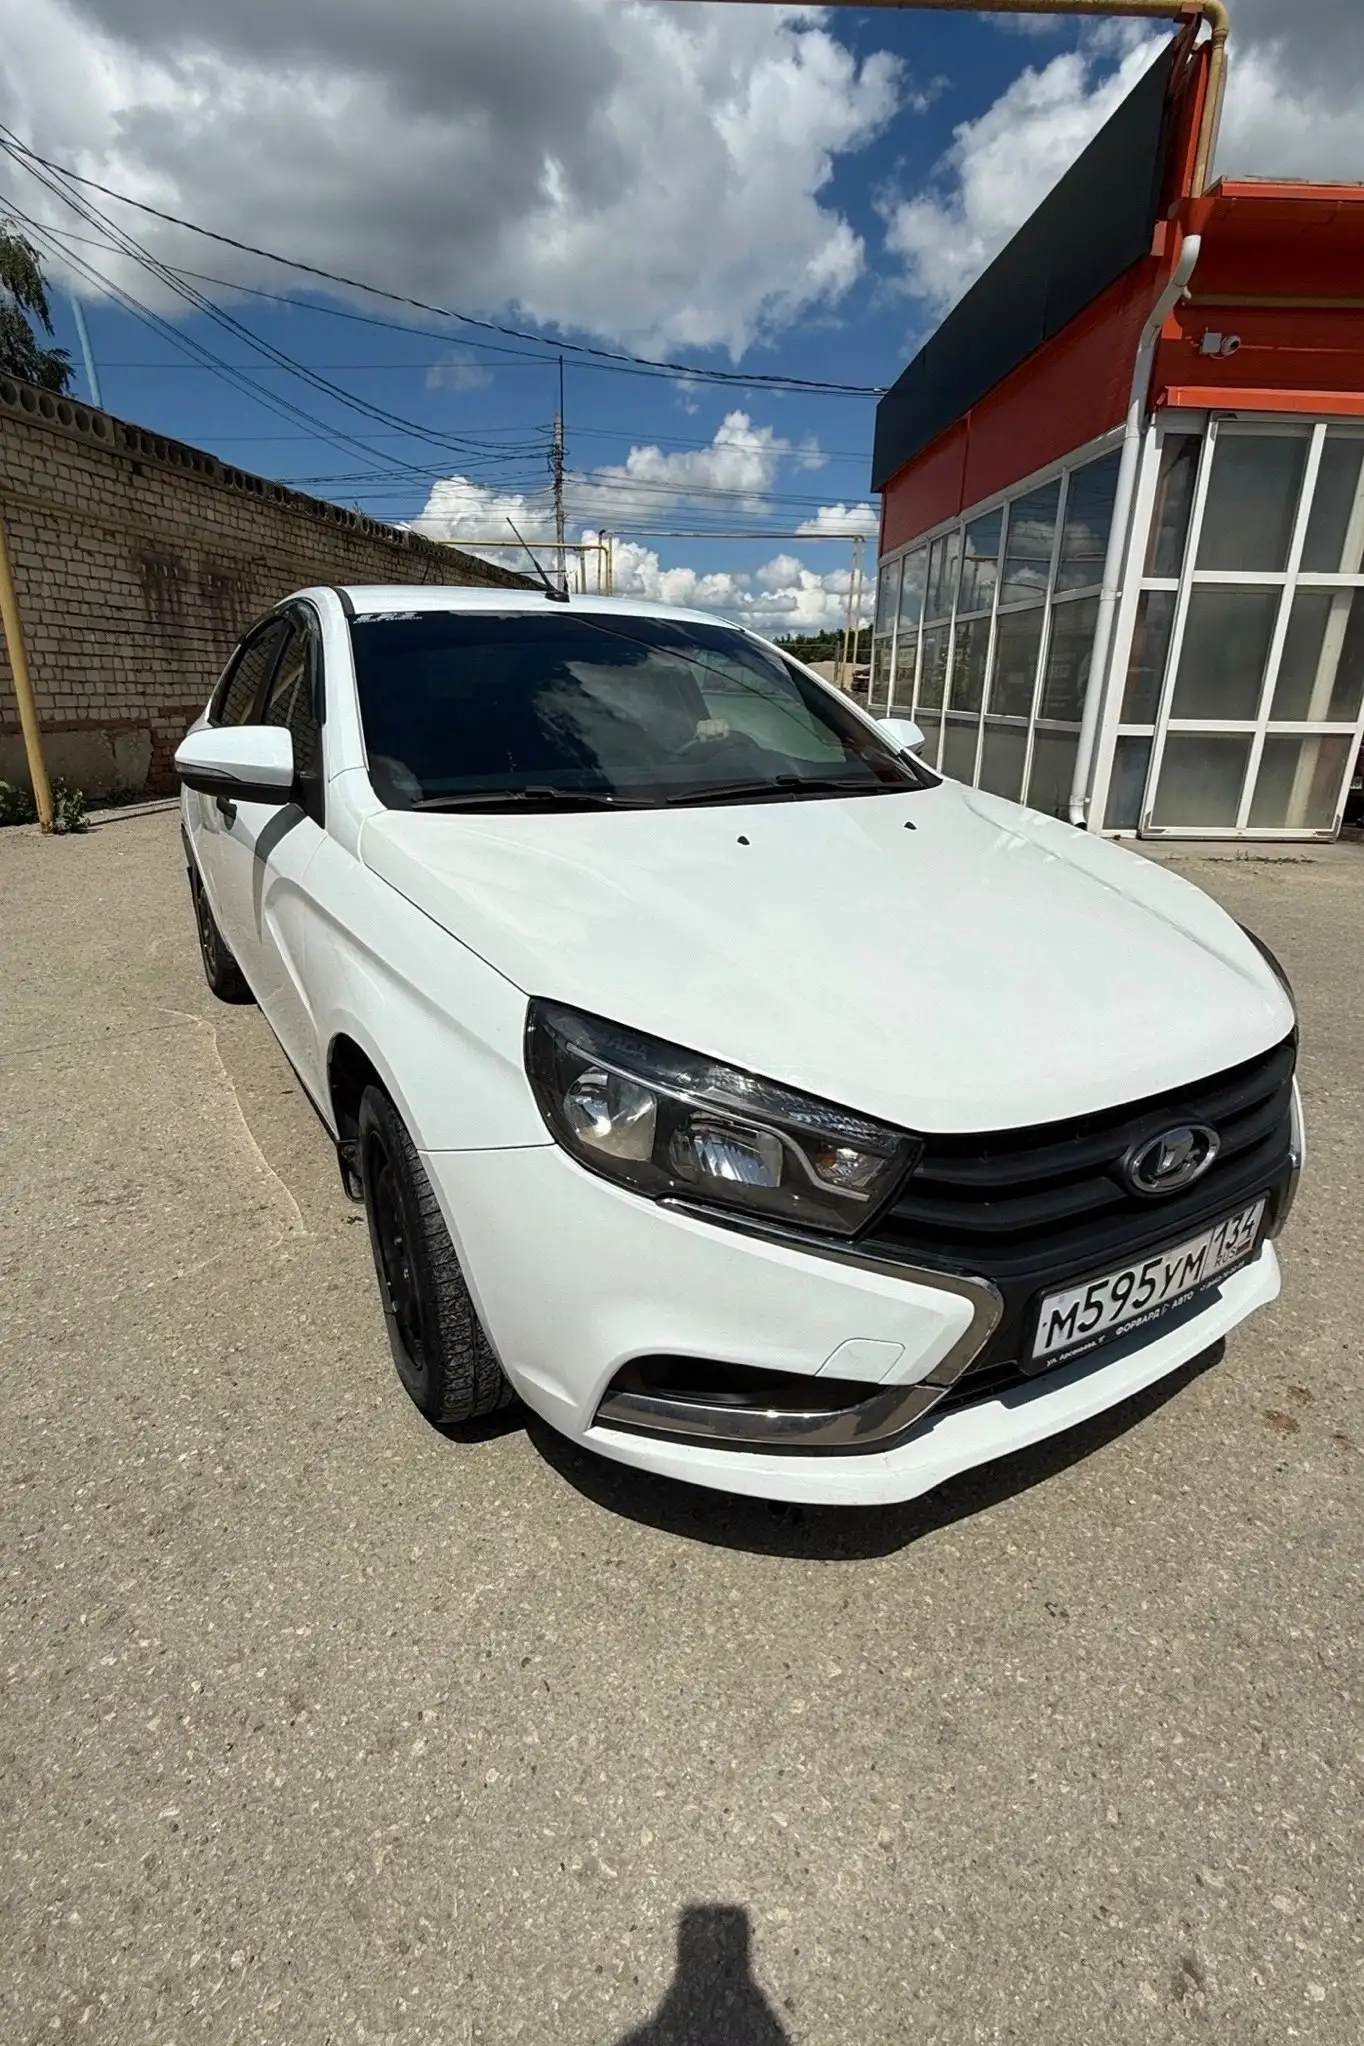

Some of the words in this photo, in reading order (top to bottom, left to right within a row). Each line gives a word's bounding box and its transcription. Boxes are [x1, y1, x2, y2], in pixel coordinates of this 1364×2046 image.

[1045, 1243, 1207, 1348] М595УМ
[1215, 1204, 1257, 1256] 134
[1215, 1246, 1236, 1268] RUS
[1115, 1308, 1161, 1335] ФОРВАРД
[1172, 1291, 1194, 1309] АВТО
